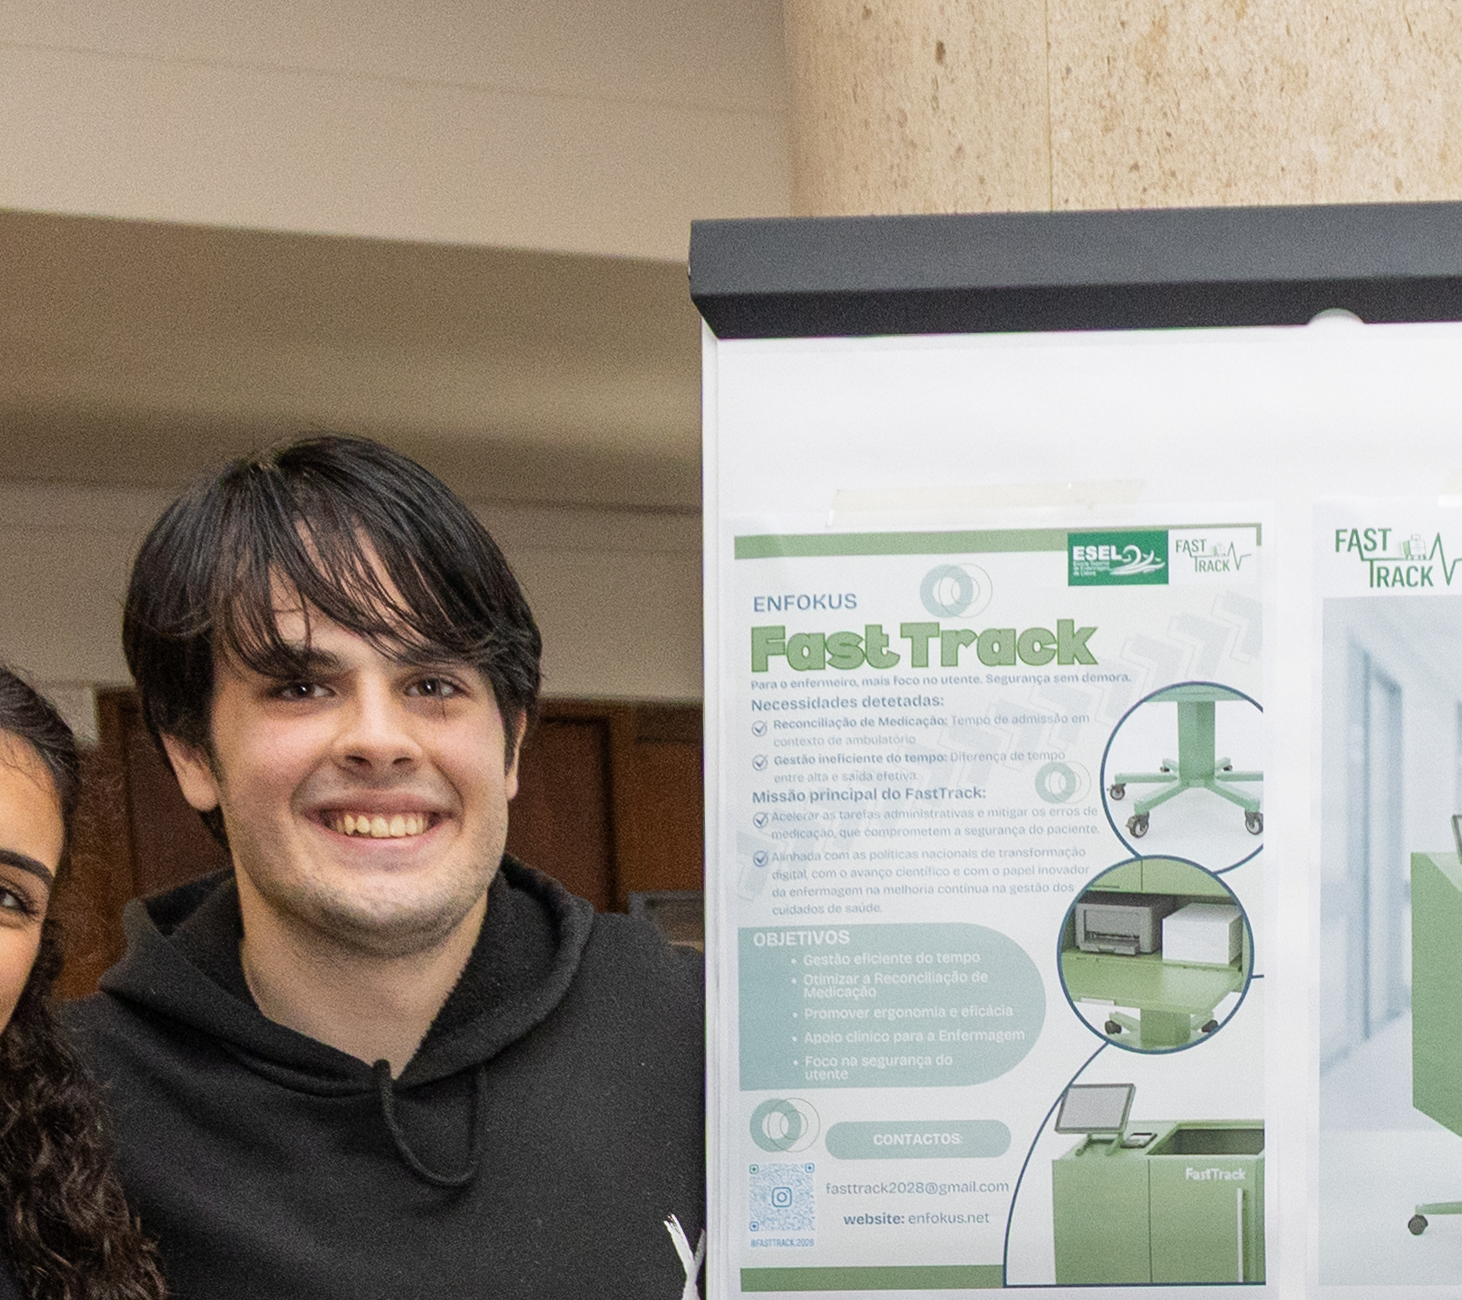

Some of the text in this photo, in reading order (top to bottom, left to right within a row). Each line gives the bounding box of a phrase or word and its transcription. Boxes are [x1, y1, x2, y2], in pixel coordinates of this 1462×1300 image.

[1175, 538, 1207, 554] FAST
[1335, 527, 1392, 554] FAST
[1073, 545, 1122, 561] ESEL
[1194, 557, 1230, 573] TRACK
[1369, 557, 1434, 588] TRACK
[752, 592, 857, 613] ENFOKUS
[750, 678, 777, 689] Para
[861, 676, 890, 687] mais
[892, 675, 920, 686] foco
[922, 678, 938, 686] no
[986, 673, 1050, 687] Segurança
[1053, 675, 1079, 683] sem
[750, 694, 944, 711] Necessidades detetadas:
[772, 717, 857, 730] Reconciliação
[860, 717, 874, 728] de
[878, 716, 946, 728] Medicação:
[994, 714, 1008, 725] de
[1011, 713, 1068, 725] admissão
[1071, 716, 1090, 724] em
[772, 734, 916, 747] contexto de ambulatório
[774, 754, 815, 765] Gestão
[818, 753, 882, 765] ineficiente
[886, 753, 901, 764] do
[904, 752, 948, 766] tempo:
[1010, 751, 1024, 761] de
[1026, 750, 1066, 763] tempo
[774, 771, 804, 782] entre
[808, 771, 828, 782] alta
[752, 787, 986, 805] Missão principal do FastTrack:
[822, 812, 835, 820] as
[838, 809, 880, 820] tarefas
[883, 808, 974, 820] administrativas
[987, 807, 1026, 820] mitigar
[1031, 809, 1046, 817] os
[1048, 808, 1080, 817] erros
[1082, 806, 1098, 816] de
[839, 830, 860, 840] que
[864, 826, 951, 840] comprometem
[964, 827, 1026, 839] segurança
[1028, 825, 1044, 835] do
[824, 852, 849, 861] com
[852, 852, 866, 860] as
[869, 849, 918, 862] políticas
[921, 848, 977, 859] nacionais
[980, 848, 995, 858] de
[998, 846, 1086, 859] transformação
[811, 870, 836, 878] com
[850, 869, 892, 879] avanço
[895, 866, 950, 877] científico
[963, 868, 989, 876] com
[1002, 865, 1035, 878] papel
[1037, 864, 1090, 875] inovador
[772, 882, 1074, 899] da enfermagem na melhoria contínua na gestão dos
[772, 904, 824, 915] cuidados
[827, 904, 841, 914] de
[753, 930, 850, 947] OBJETIVOS
[803, 952, 981, 966] Gestão eficiente do tempo
[804, 974, 859, 985] Otimizar
[874, 972, 968, 986] Reconciliação
[971, 972, 988, 983] de
[804, 986, 876, 1000] Medicação
[804, 1007, 868, 1019] Promover
[873, 1006, 946, 1021] ergonomia
[961, 1006, 1014, 1017] eficácia
[804, 1032, 842, 1046] Apoio
[845, 1031, 889, 1043] clínico
[893, 1033, 923, 1045] para
[938, 1030, 1026, 1044] Enfermagem
[804, 1054, 953, 1069] Foco na segurança do
[805, 1068, 848, 1080] utente
[1185, 1167, 1246, 1180] FastTrack
[826, 1181, 1009, 1197] fasttrack2028@gmail.com
[843, 1212, 990, 1226] website: enfokus.net
